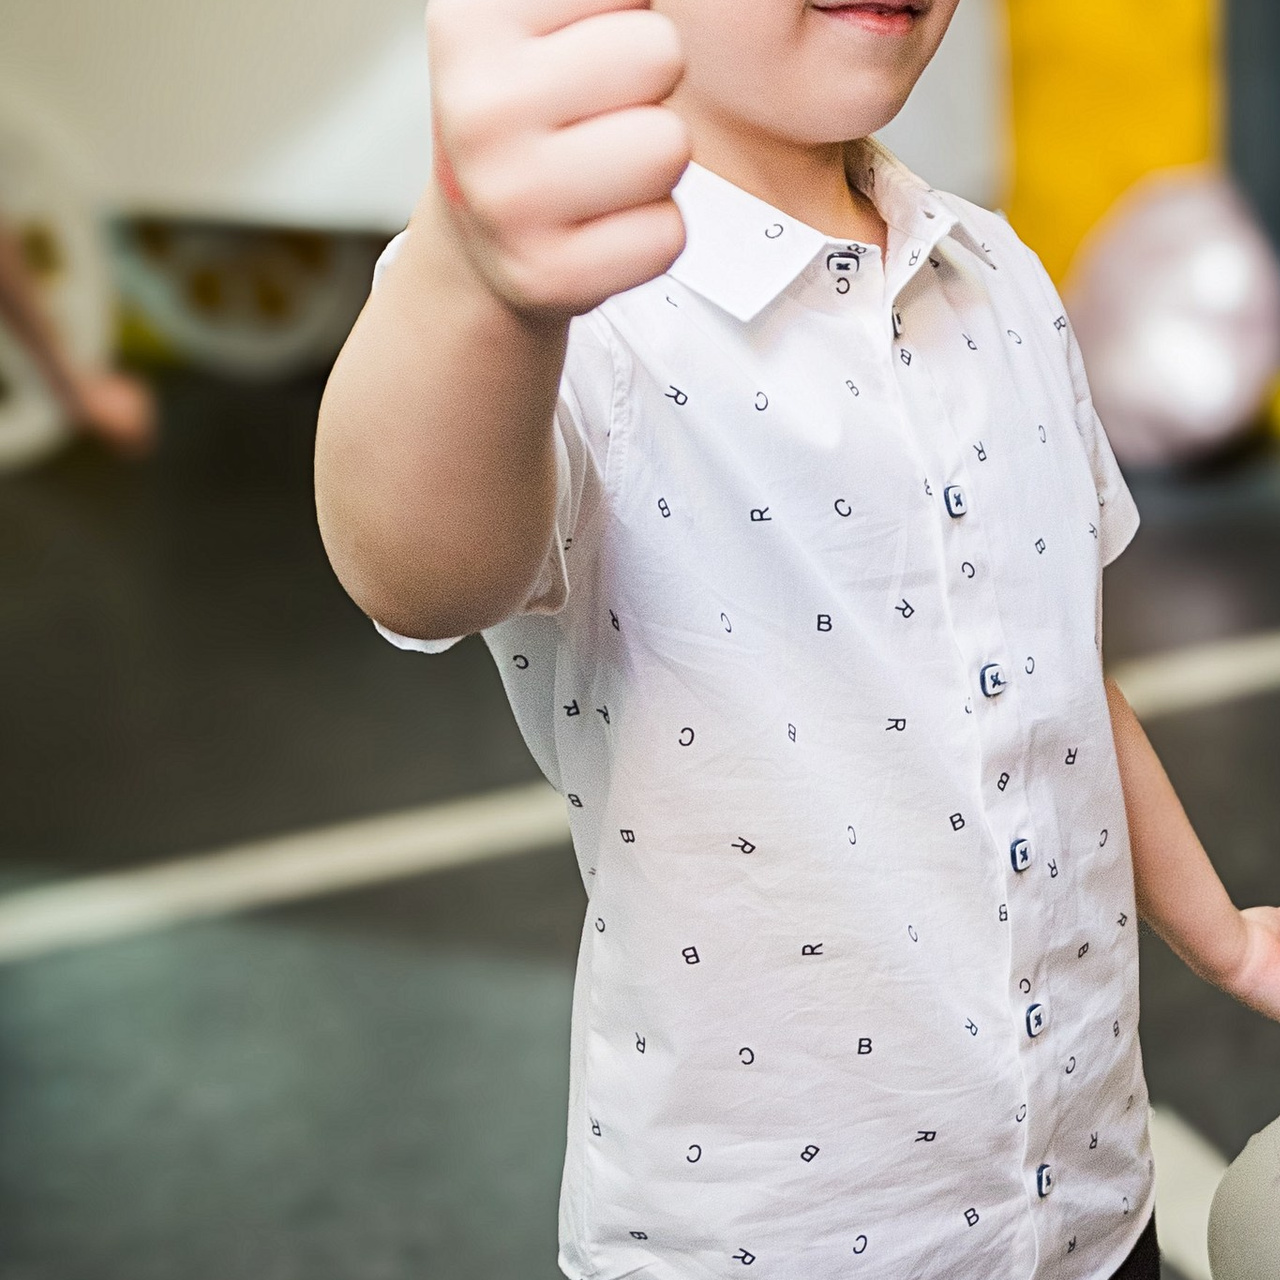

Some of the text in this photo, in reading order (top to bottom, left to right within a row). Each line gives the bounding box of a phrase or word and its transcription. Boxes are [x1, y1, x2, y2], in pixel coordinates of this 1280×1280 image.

[764, 224, 784, 239] C
[836, 276, 851, 295] C
[900, 348, 912, 366] B
[664, 385, 688, 406] R
[755, 391, 769, 412] C
[973, 441, 987, 462] R
[657, 497, 671, 518] B
[750, 507, 772, 522] R
[834, 498, 852, 518] C
[1034, 538, 1046, 555] B
[961, 561, 976, 579] C
[895, 598, 915, 619] R
[816, 614, 833, 633] B
[513, 654, 529, 670] C
[563, 699, 581, 717] R
[885, 718, 907, 732] R
[678, 727, 695, 747] C
[1065, 748, 1078, 765] R
[997, 772, 1010, 792] B
[949, 812, 966, 832] B
[619, 829, 636, 844] B
[731, 836, 756, 855] R
[595, 917, 606, 933] C
[681, 946, 700, 965] B
[801, 943, 823, 956] R
[1019, 978, 1032, 994] C
[965, 1017, 979, 1036] R
[857, 1037, 873, 1055] B
[738, 1047, 755, 1066] C
[1064, 1056, 1076, 1074] C
[914, 1130, 937, 1143] R
[686, 1144, 702, 1164] C
[800, 1144, 820, 1163] B
[964, 1207, 979, 1227] B
[852, 1234, 868, 1255] C
[732, 1247, 756, 1266] R
